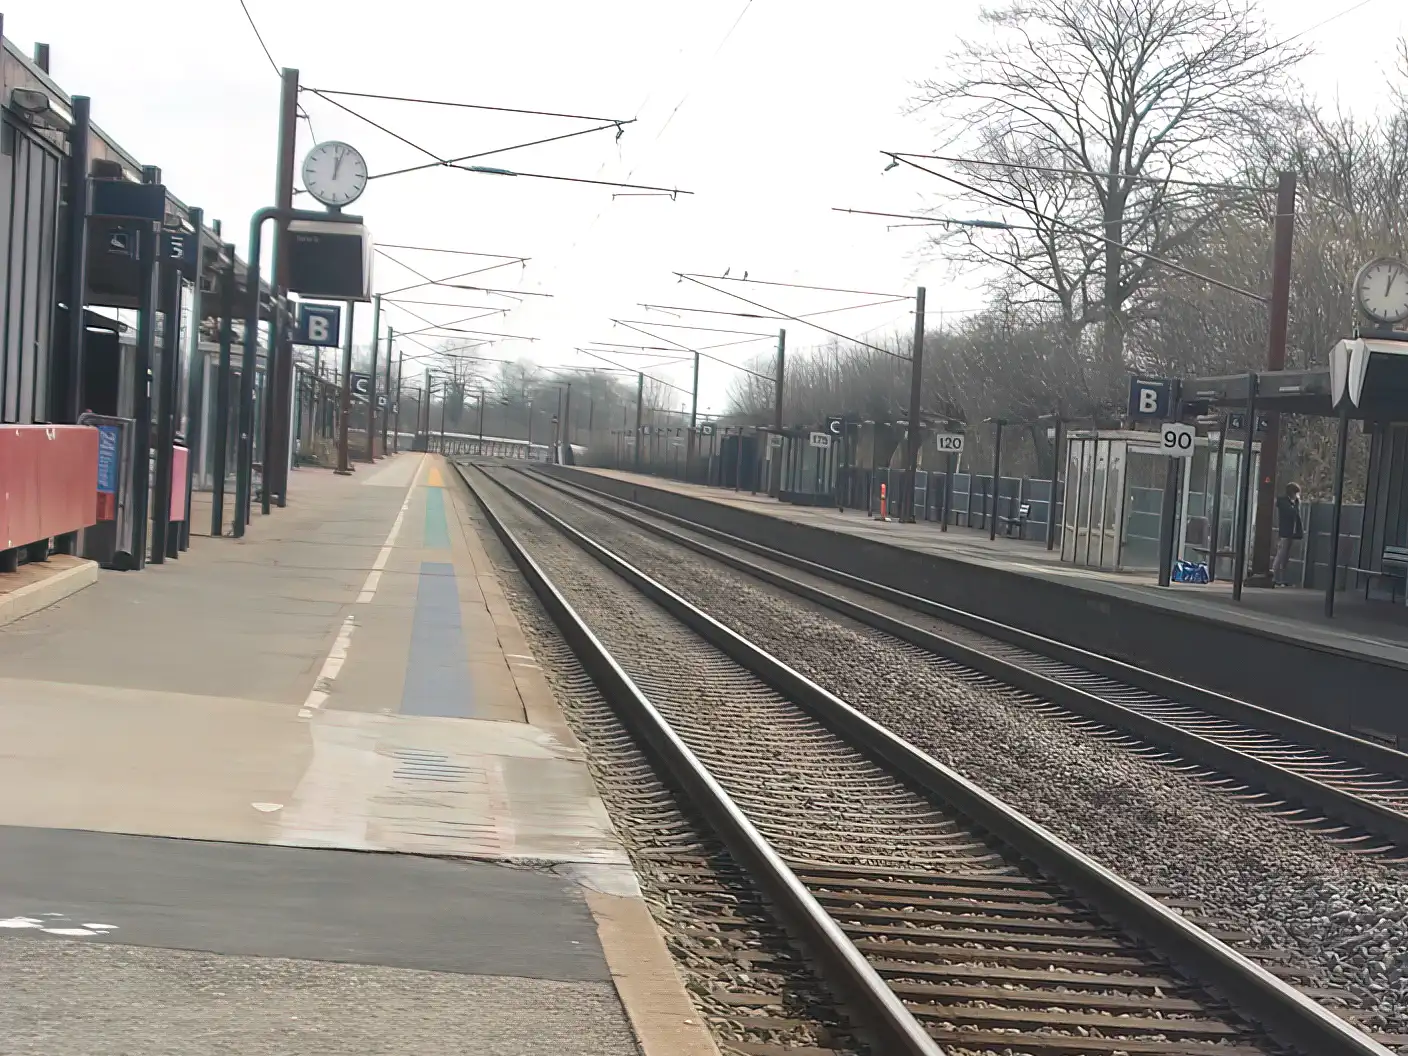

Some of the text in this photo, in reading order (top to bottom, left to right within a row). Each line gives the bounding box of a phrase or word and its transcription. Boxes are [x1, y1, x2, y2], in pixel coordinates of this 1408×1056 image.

[308, 315, 329, 341] B
[356, 378, 368, 393] C
[1139, 388, 1157, 413] B
[830, 420, 841, 433] C
[939, 437, 962, 450] 120
[1164, 430, 1193, 449] 90
